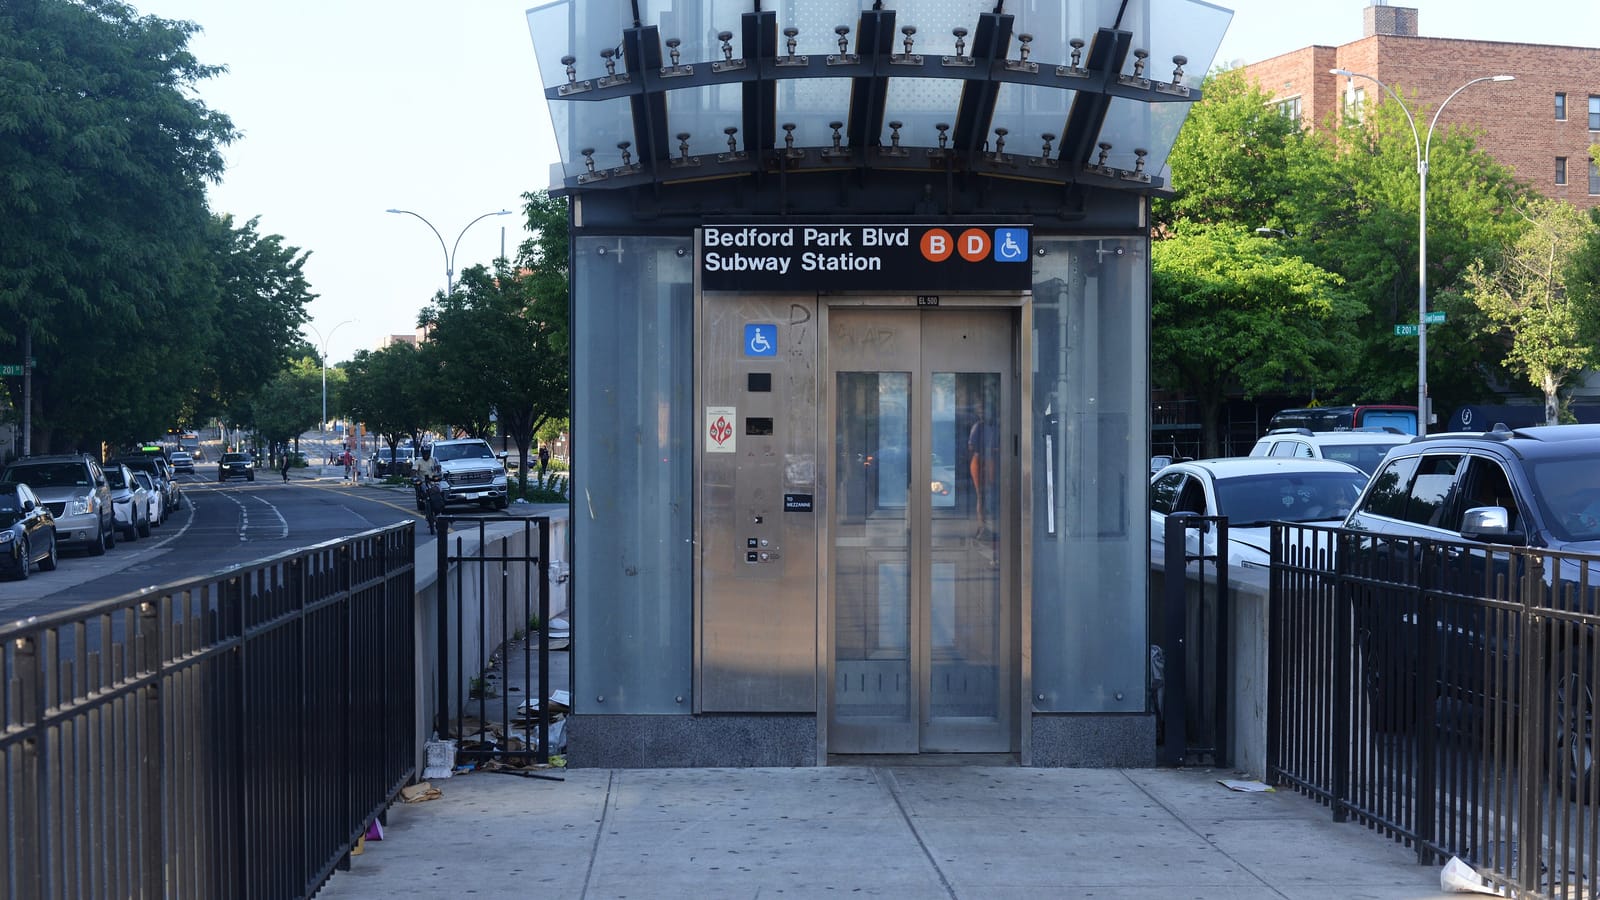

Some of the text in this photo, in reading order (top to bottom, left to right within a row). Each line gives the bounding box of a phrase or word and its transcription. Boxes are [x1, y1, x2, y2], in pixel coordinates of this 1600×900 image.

[704, 228, 909, 247] Bedford Park Blvd
[930, 235, 946, 254] B
[967, 235, 984, 254] D
[705, 252, 881, 274] Subway Station
[1397, 326, 1401, 334] E
[1402, 326, 1411, 334] 201
[3, 365, 13, 375] 201
